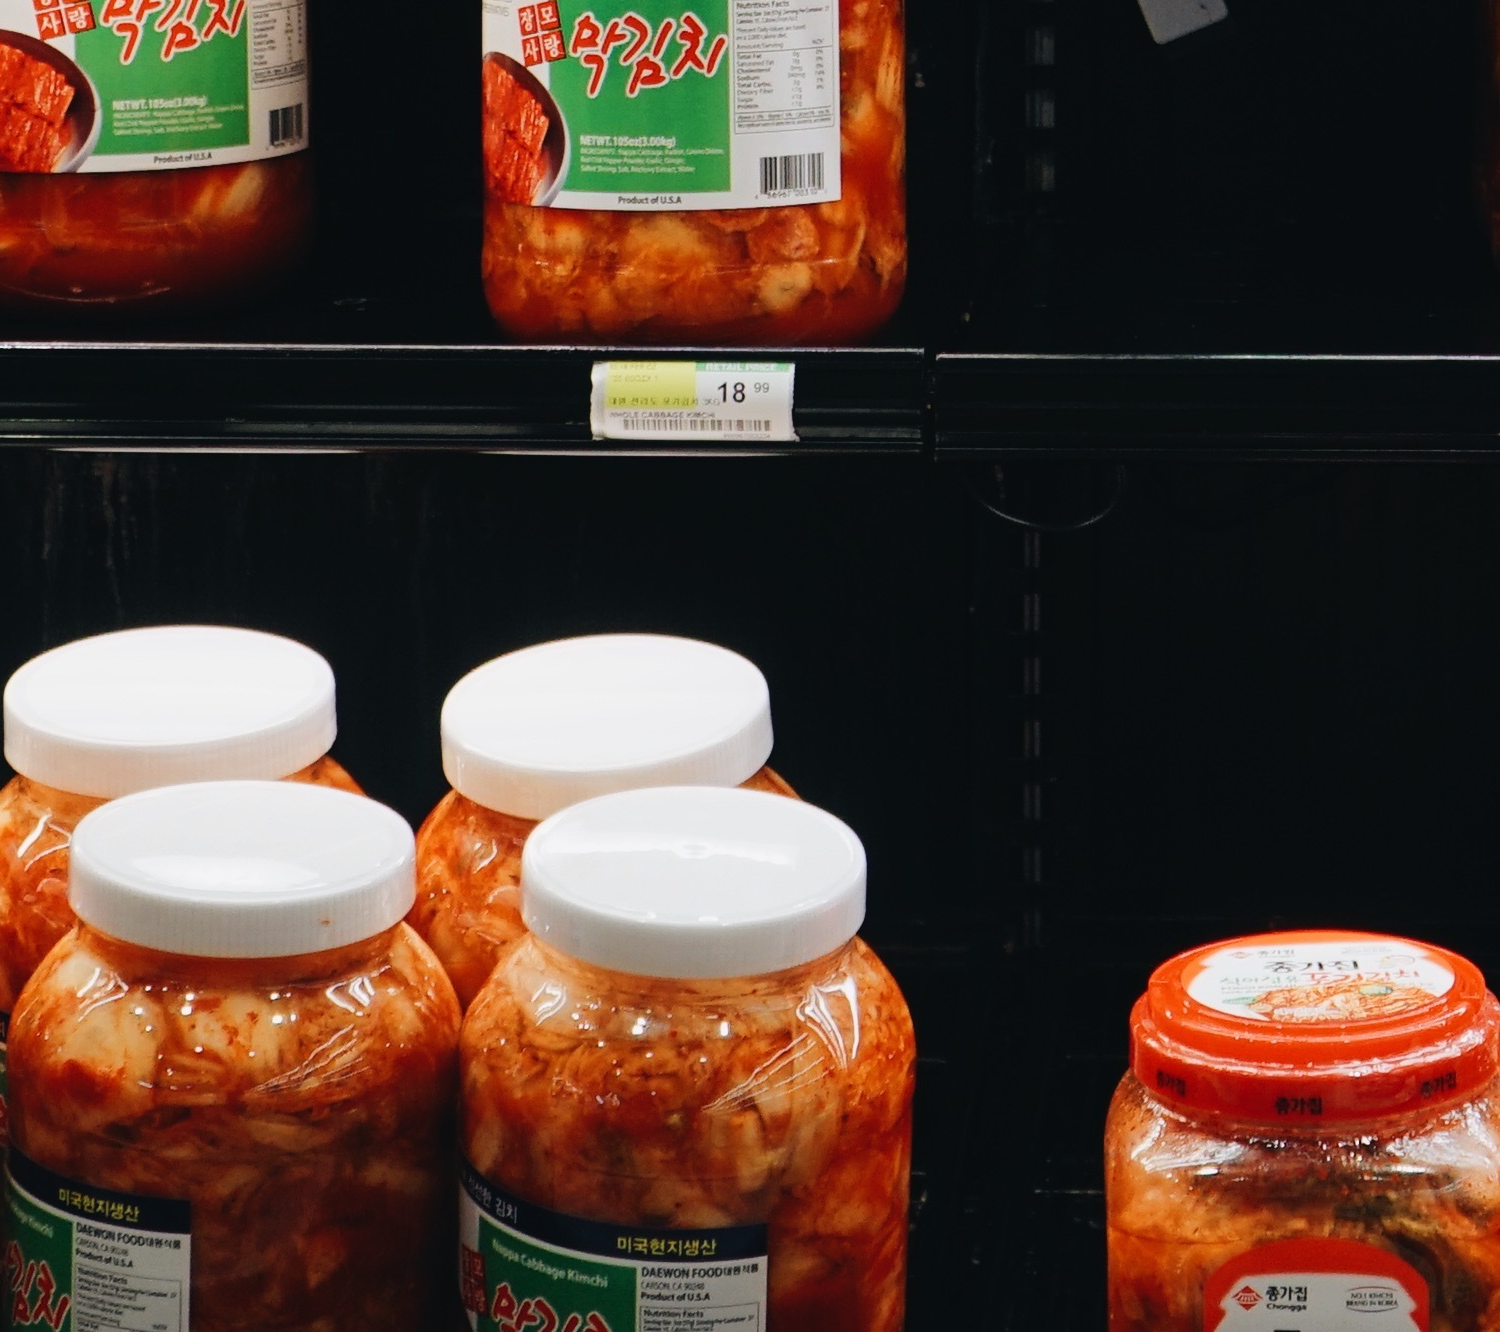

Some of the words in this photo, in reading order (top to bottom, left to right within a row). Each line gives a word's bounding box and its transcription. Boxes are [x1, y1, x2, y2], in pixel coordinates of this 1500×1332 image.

[716, 382, 746, 404] 18
[753, 382, 770, 394] 99
[617, 1235, 717, 1255] 미국현지생산
